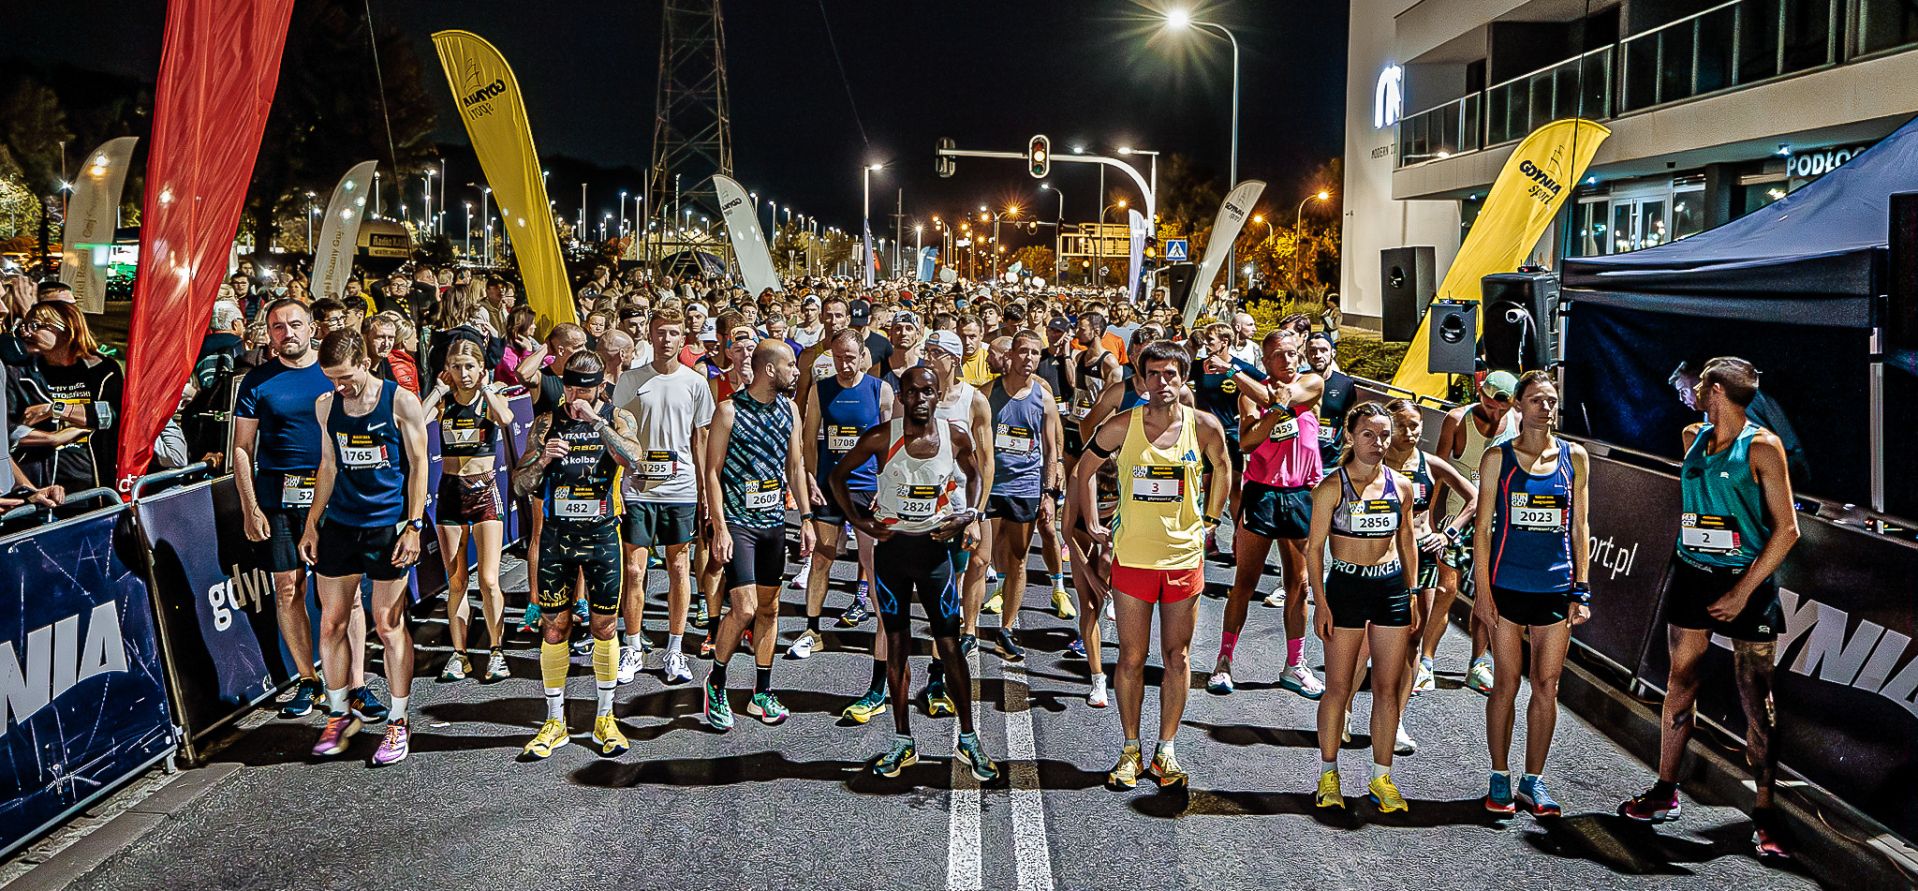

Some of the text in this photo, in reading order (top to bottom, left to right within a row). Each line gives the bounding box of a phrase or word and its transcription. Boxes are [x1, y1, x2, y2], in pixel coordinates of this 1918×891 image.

[1519, 160, 1562, 196] GDYNIA
[1528, 184, 1555, 205] sport
[457, 432, 463, 441] 7
[557, 431, 601, 441] VITARAD
[833, 438, 855, 447] 1708
[344, 450, 372, 461] 1765
[570, 456, 596, 464] kolba
[643, 463, 667, 473] 1295
[1151, 482, 1159, 493] 3
[753, 493, 777, 505] 2609
[565, 503, 588, 513] 482
[902, 500, 931, 512] 2824
[1360, 516, 1390, 528] 2856
[1520, 511, 1553, 522] 2023
[1702, 532, 1711, 544] 2
[1361, 561, 1394, 577] NIKE
[1773, 586, 1918, 721] YNIA
[0, 599, 129, 738] NIA
